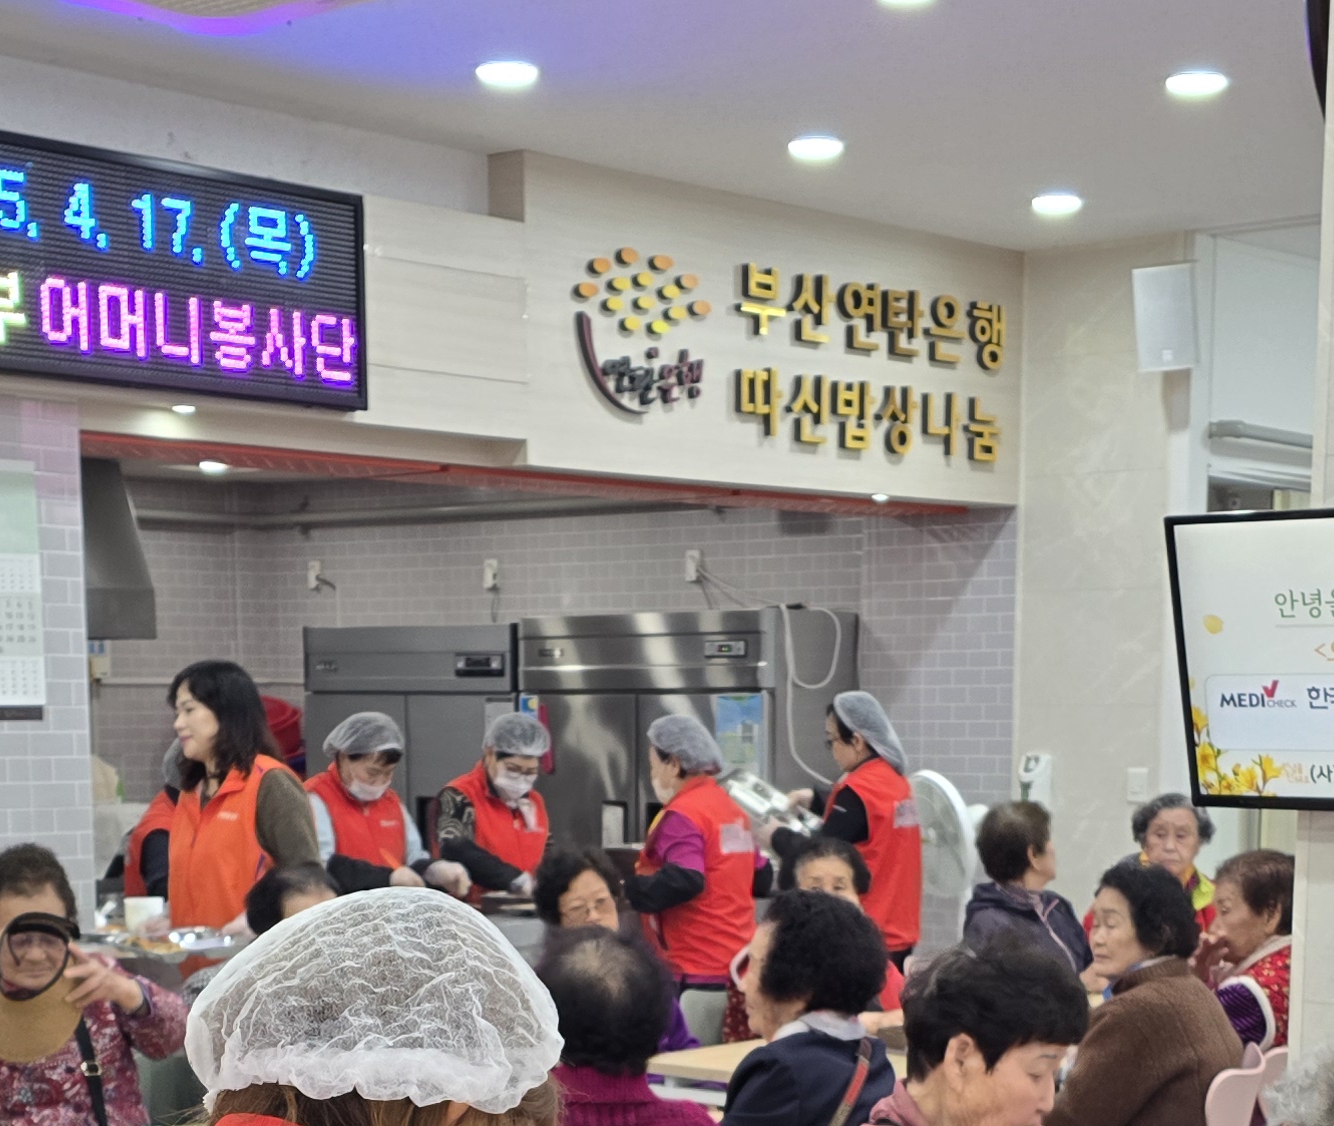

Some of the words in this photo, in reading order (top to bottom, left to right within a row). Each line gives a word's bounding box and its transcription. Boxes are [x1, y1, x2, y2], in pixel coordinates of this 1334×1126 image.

[40, 273, 357, 386] 어머니봉사단
[737, 262, 1007, 372] 부산연탄은행
[735, 366, 1002, 463] 따신밥상나눔
